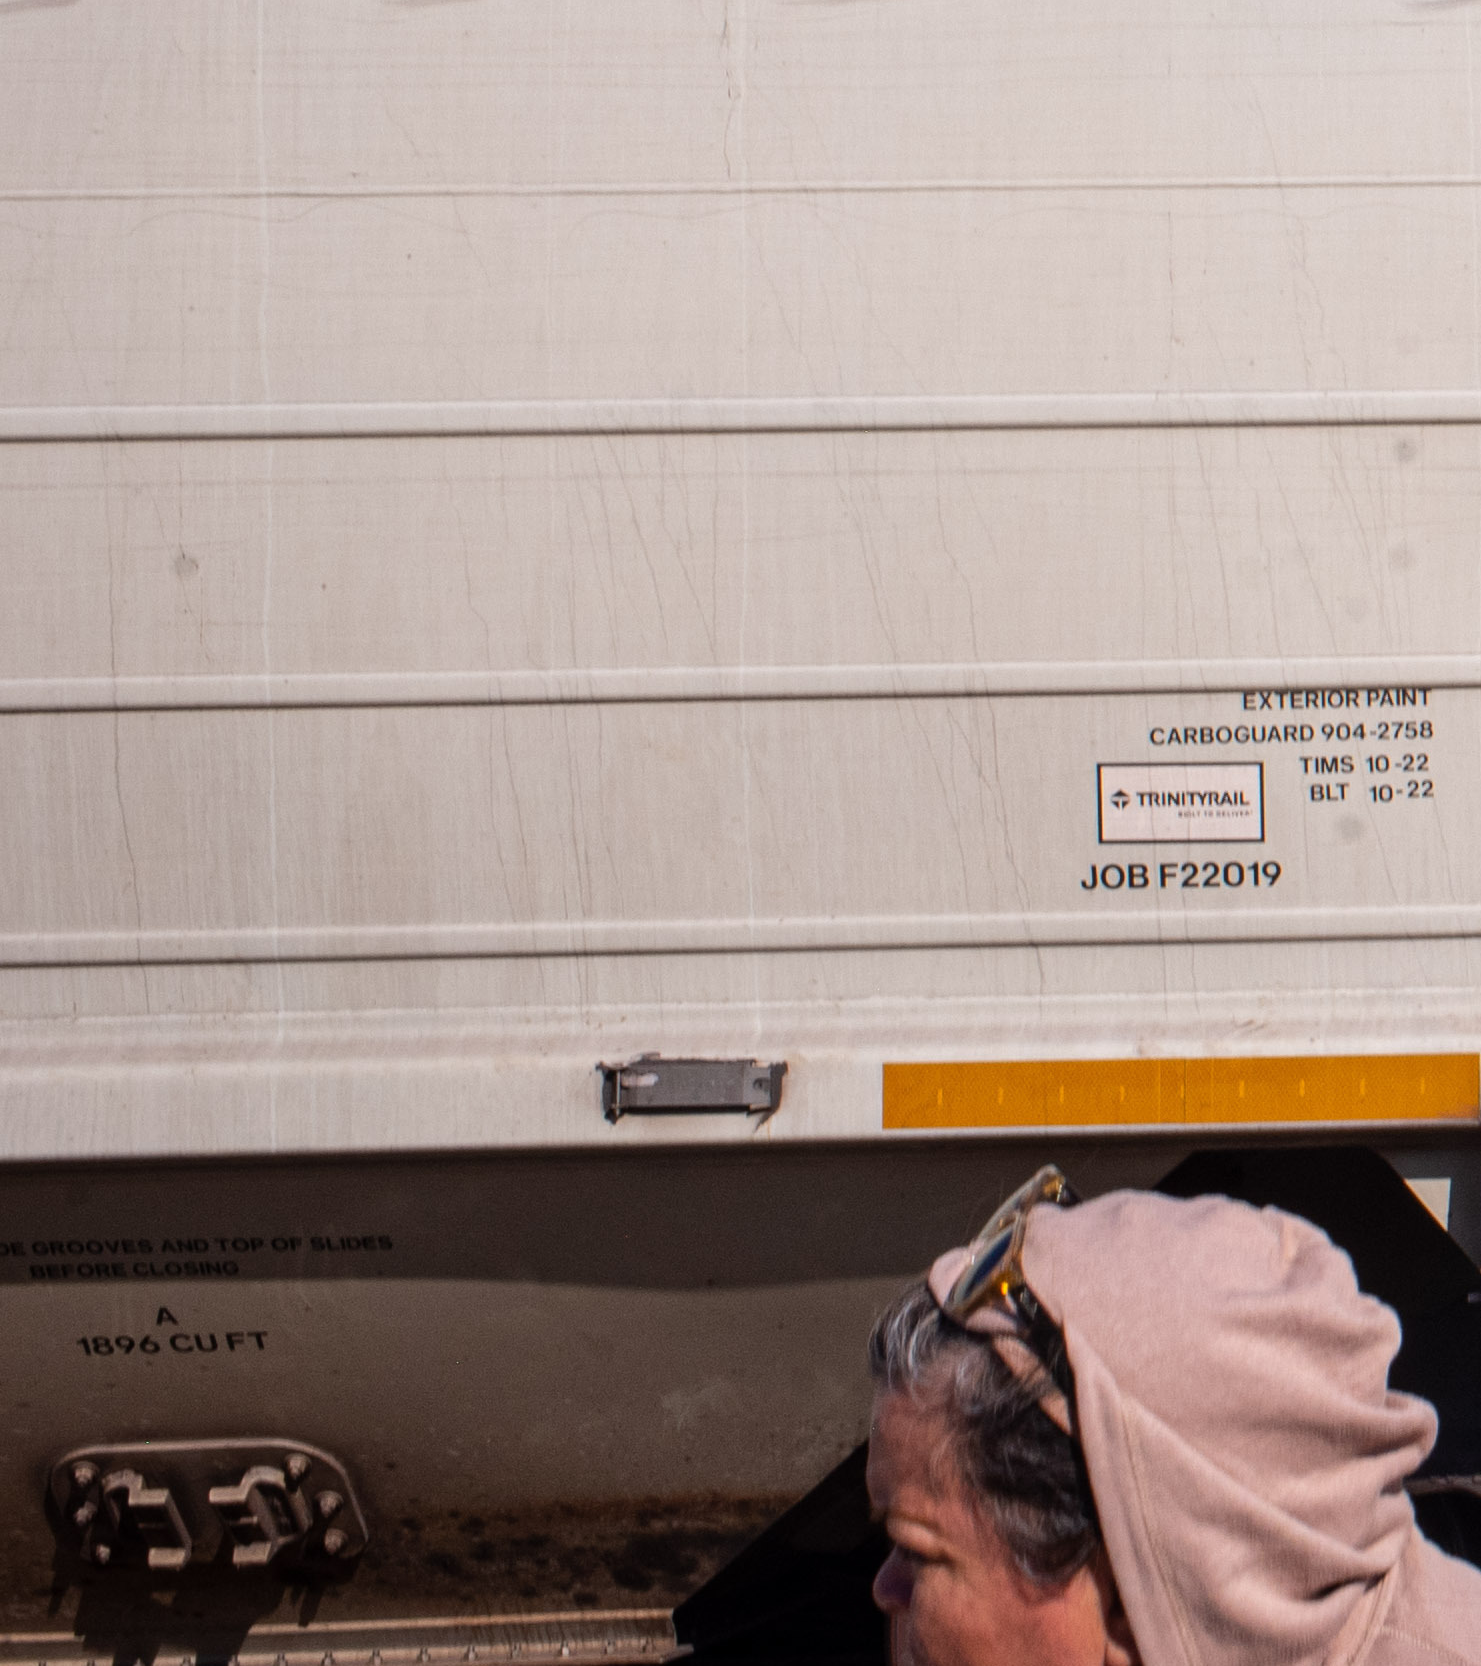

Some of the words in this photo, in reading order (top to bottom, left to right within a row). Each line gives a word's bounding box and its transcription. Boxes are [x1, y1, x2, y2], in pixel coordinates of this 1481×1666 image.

[1243, 690, 1358, 710] EXTERIOR
[1367, 689, 1431, 707] PAINT
[1150, 725, 1314, 745] CARBOGUARD
[1321, 721, 1433, 740] 904-2758
[1300, 756, 1354, 774] TIMS
[1137, 791, 1250, 807] TRINITYRAIL
[1310, 783, 1349, 802] BLT
[1080, 864, 1149, 890] JOB
[1159, 861, 1282, 888] F22019
[32, 1239, 153, 1257] GROOVES
[161, 1238, 209, 1254] AND
[215, 1236, 264, 1253] TOP
[271, 1235, 302, 1252] OF
[309, 1234, 393, 1252] SLIDES
[29, 1262, 127, 1280] BEFORE
[132, 1260, 239, 1278] CLOSING
[155, 1306, 179, 1326] A
[76, 1335, 161, 1357] 1896
[169, 1333, 219, 1354] CU
[227, 1331, 268, 1352] FT
